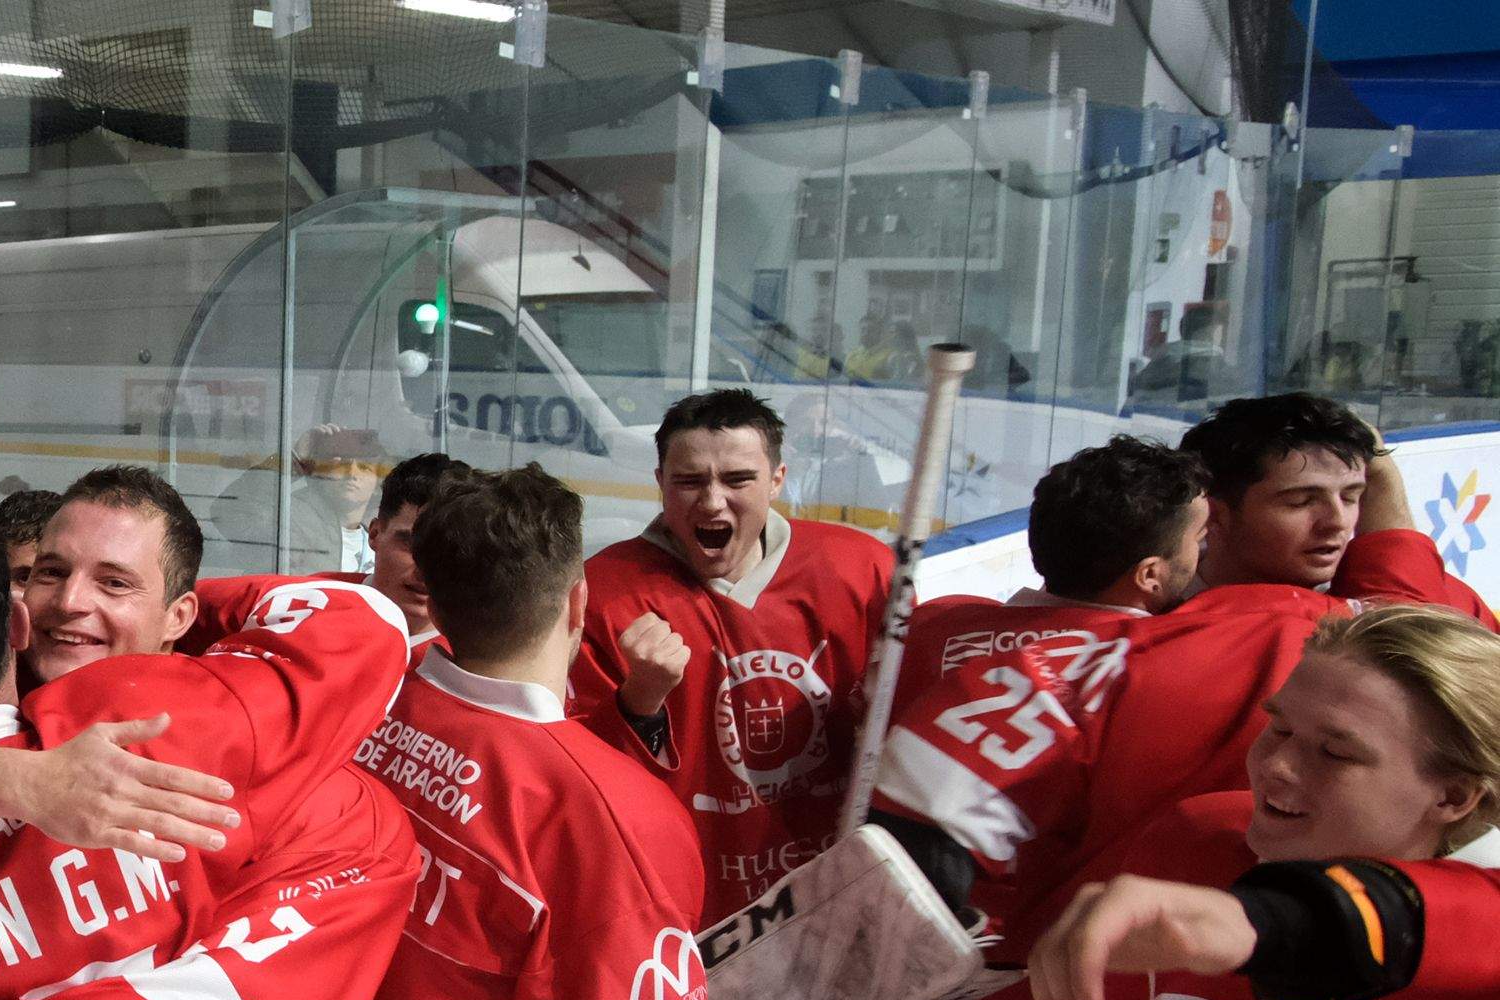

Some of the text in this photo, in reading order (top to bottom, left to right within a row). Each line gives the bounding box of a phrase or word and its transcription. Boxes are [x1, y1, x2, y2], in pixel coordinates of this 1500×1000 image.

[372, 715, 482, 785] GOBIERNO
[933, 676, 1077, 770] 25
[353, 738, 483, 825] DE ARAGON
[697, 884, 795, 970] CM
